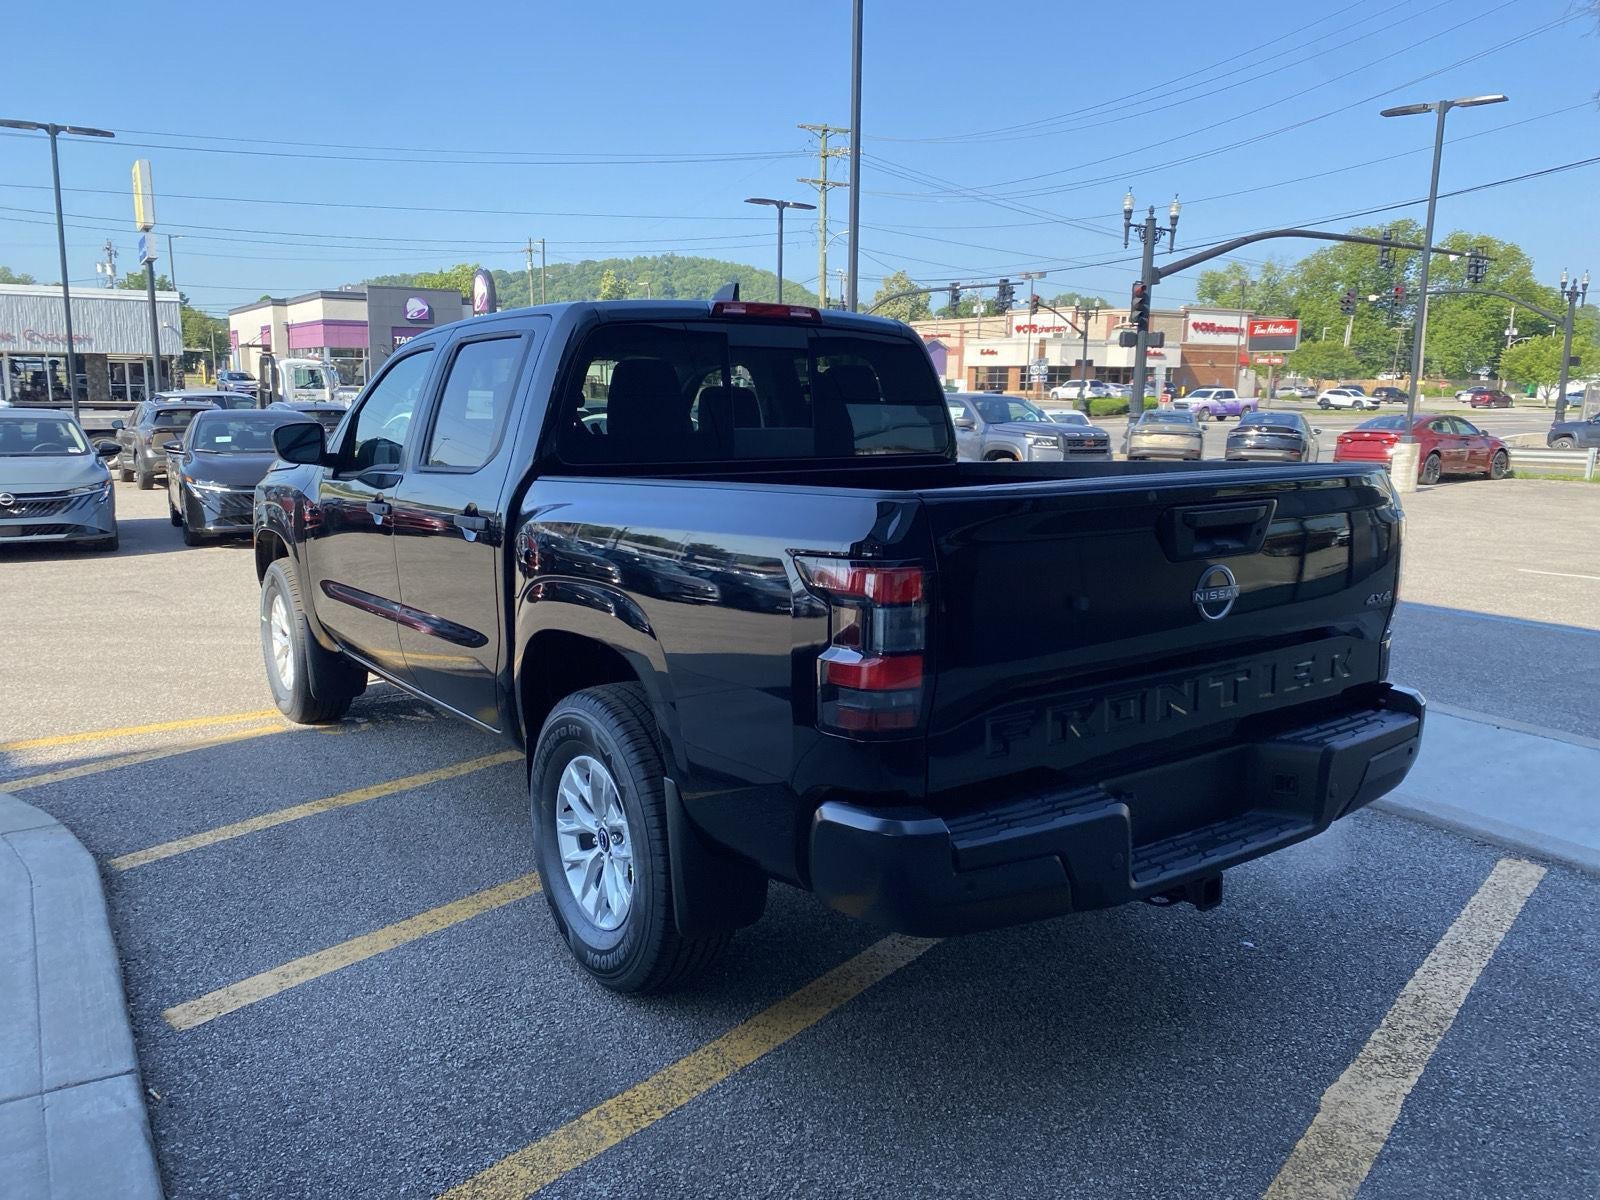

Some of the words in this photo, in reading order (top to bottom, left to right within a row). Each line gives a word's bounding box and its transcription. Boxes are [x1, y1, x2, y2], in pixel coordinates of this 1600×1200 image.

[1022, 324, 1038, 333] CVS
[1038, 325, 1068, 334] pharmacy
[1253, 324, 1265, 335] Tim
[1265, 323, 1294, 334] Hortons
[1195, 586, 1240, 601] NISSAN
[985, 649, 1352, 758] FRONTIER
